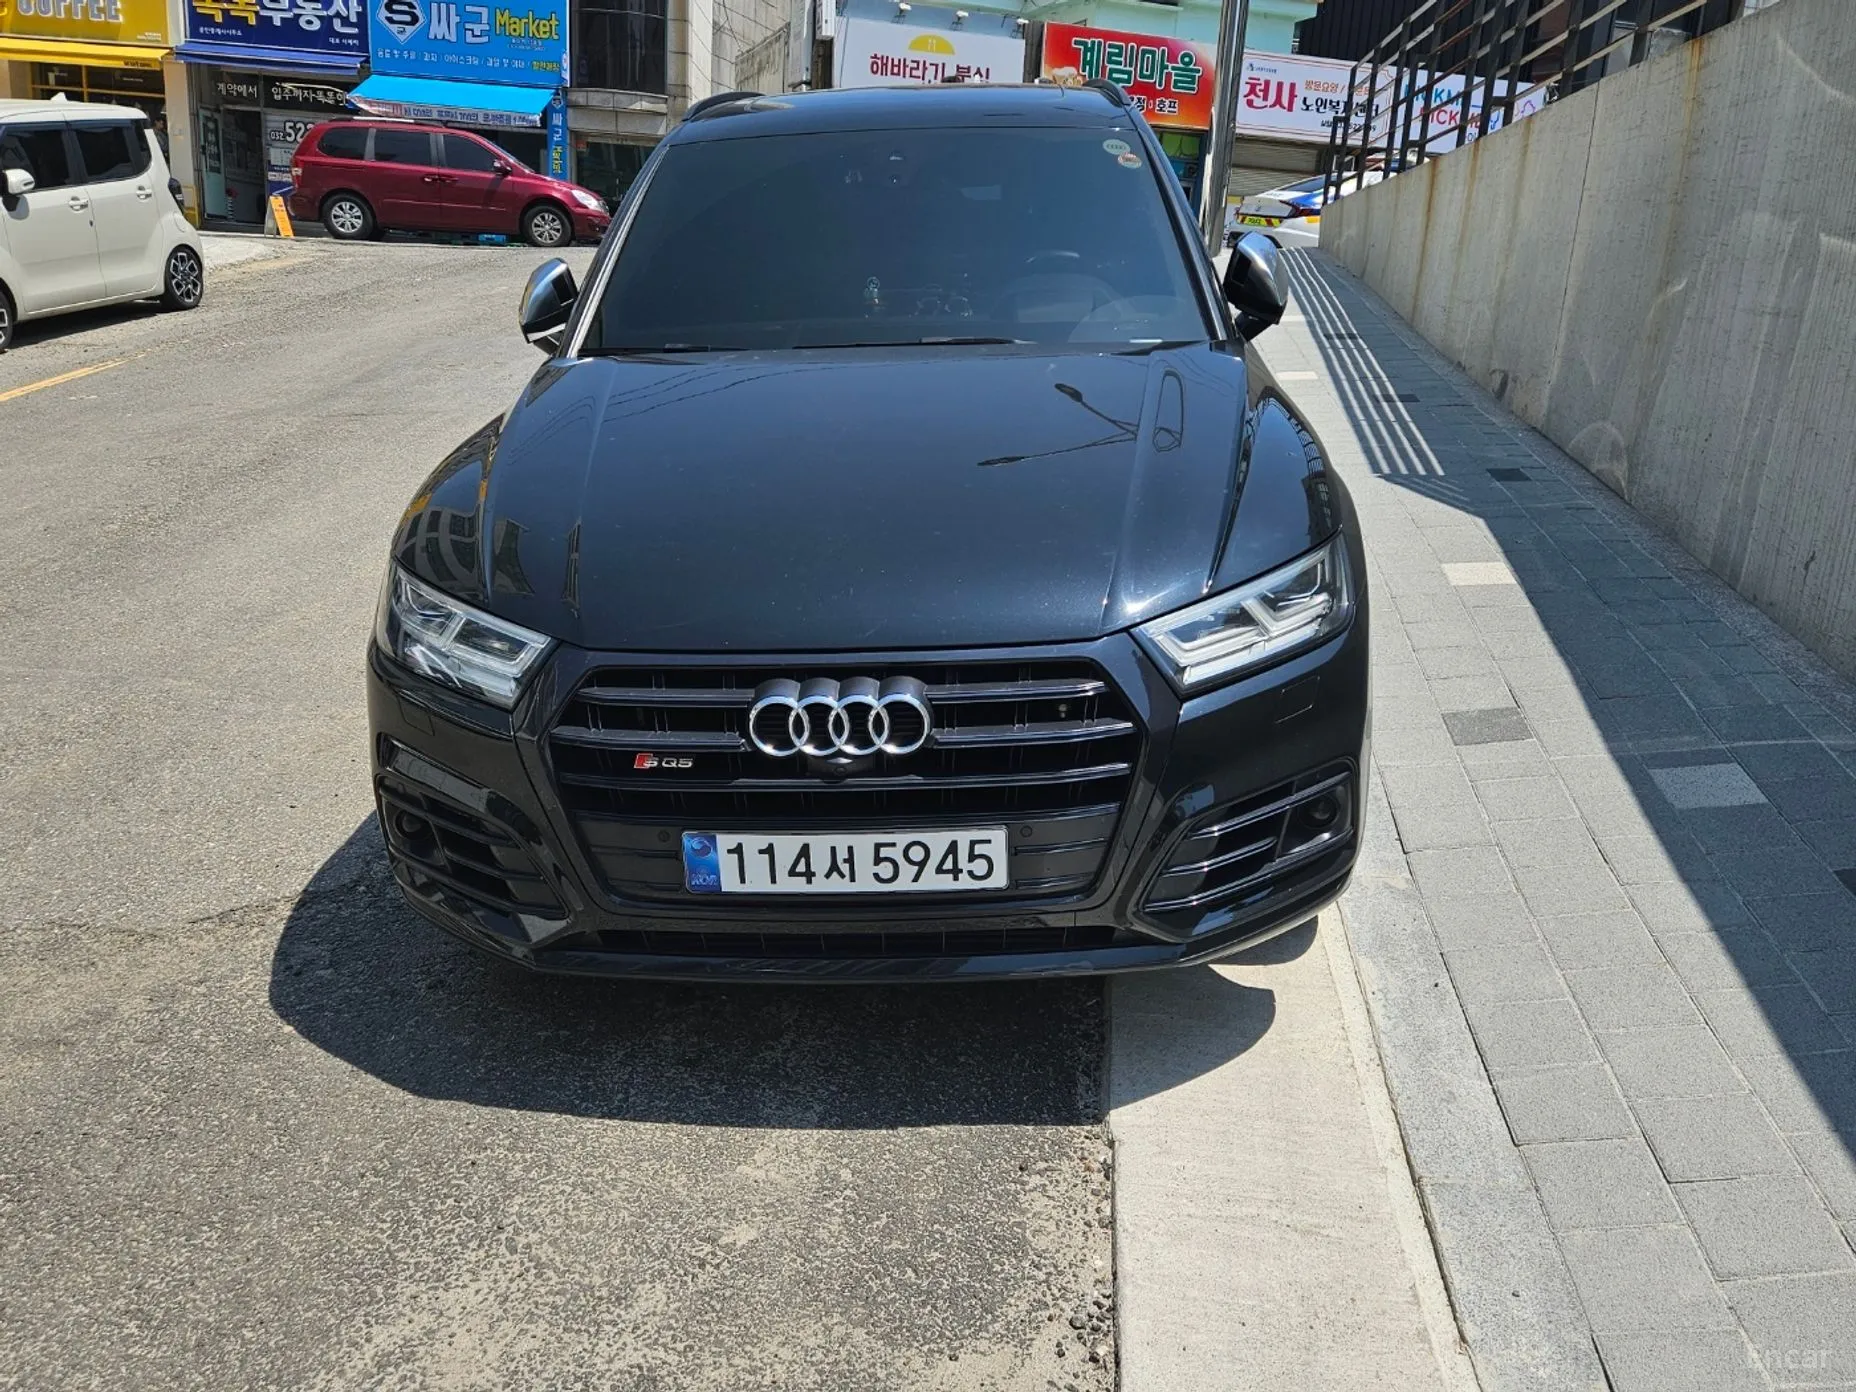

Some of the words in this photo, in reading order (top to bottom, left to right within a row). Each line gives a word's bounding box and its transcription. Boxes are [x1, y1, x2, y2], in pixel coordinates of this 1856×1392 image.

[428, 2, 490, 44] 싸군
[495, 8, 560, 40] Market
[869, 53, 946, 83] 해바라기
[1072, 38, 1202, 93] 계림마을
[216, 82, 258, 98] 계약에서
[1156, 97, 1179, 114] 호프
[1243, 76, 1298, 112] 천사
[636, 753, 693, 769] SQ5
[725, 841, 857, 885] 114서
[872, 838, 995, 883] 5945
